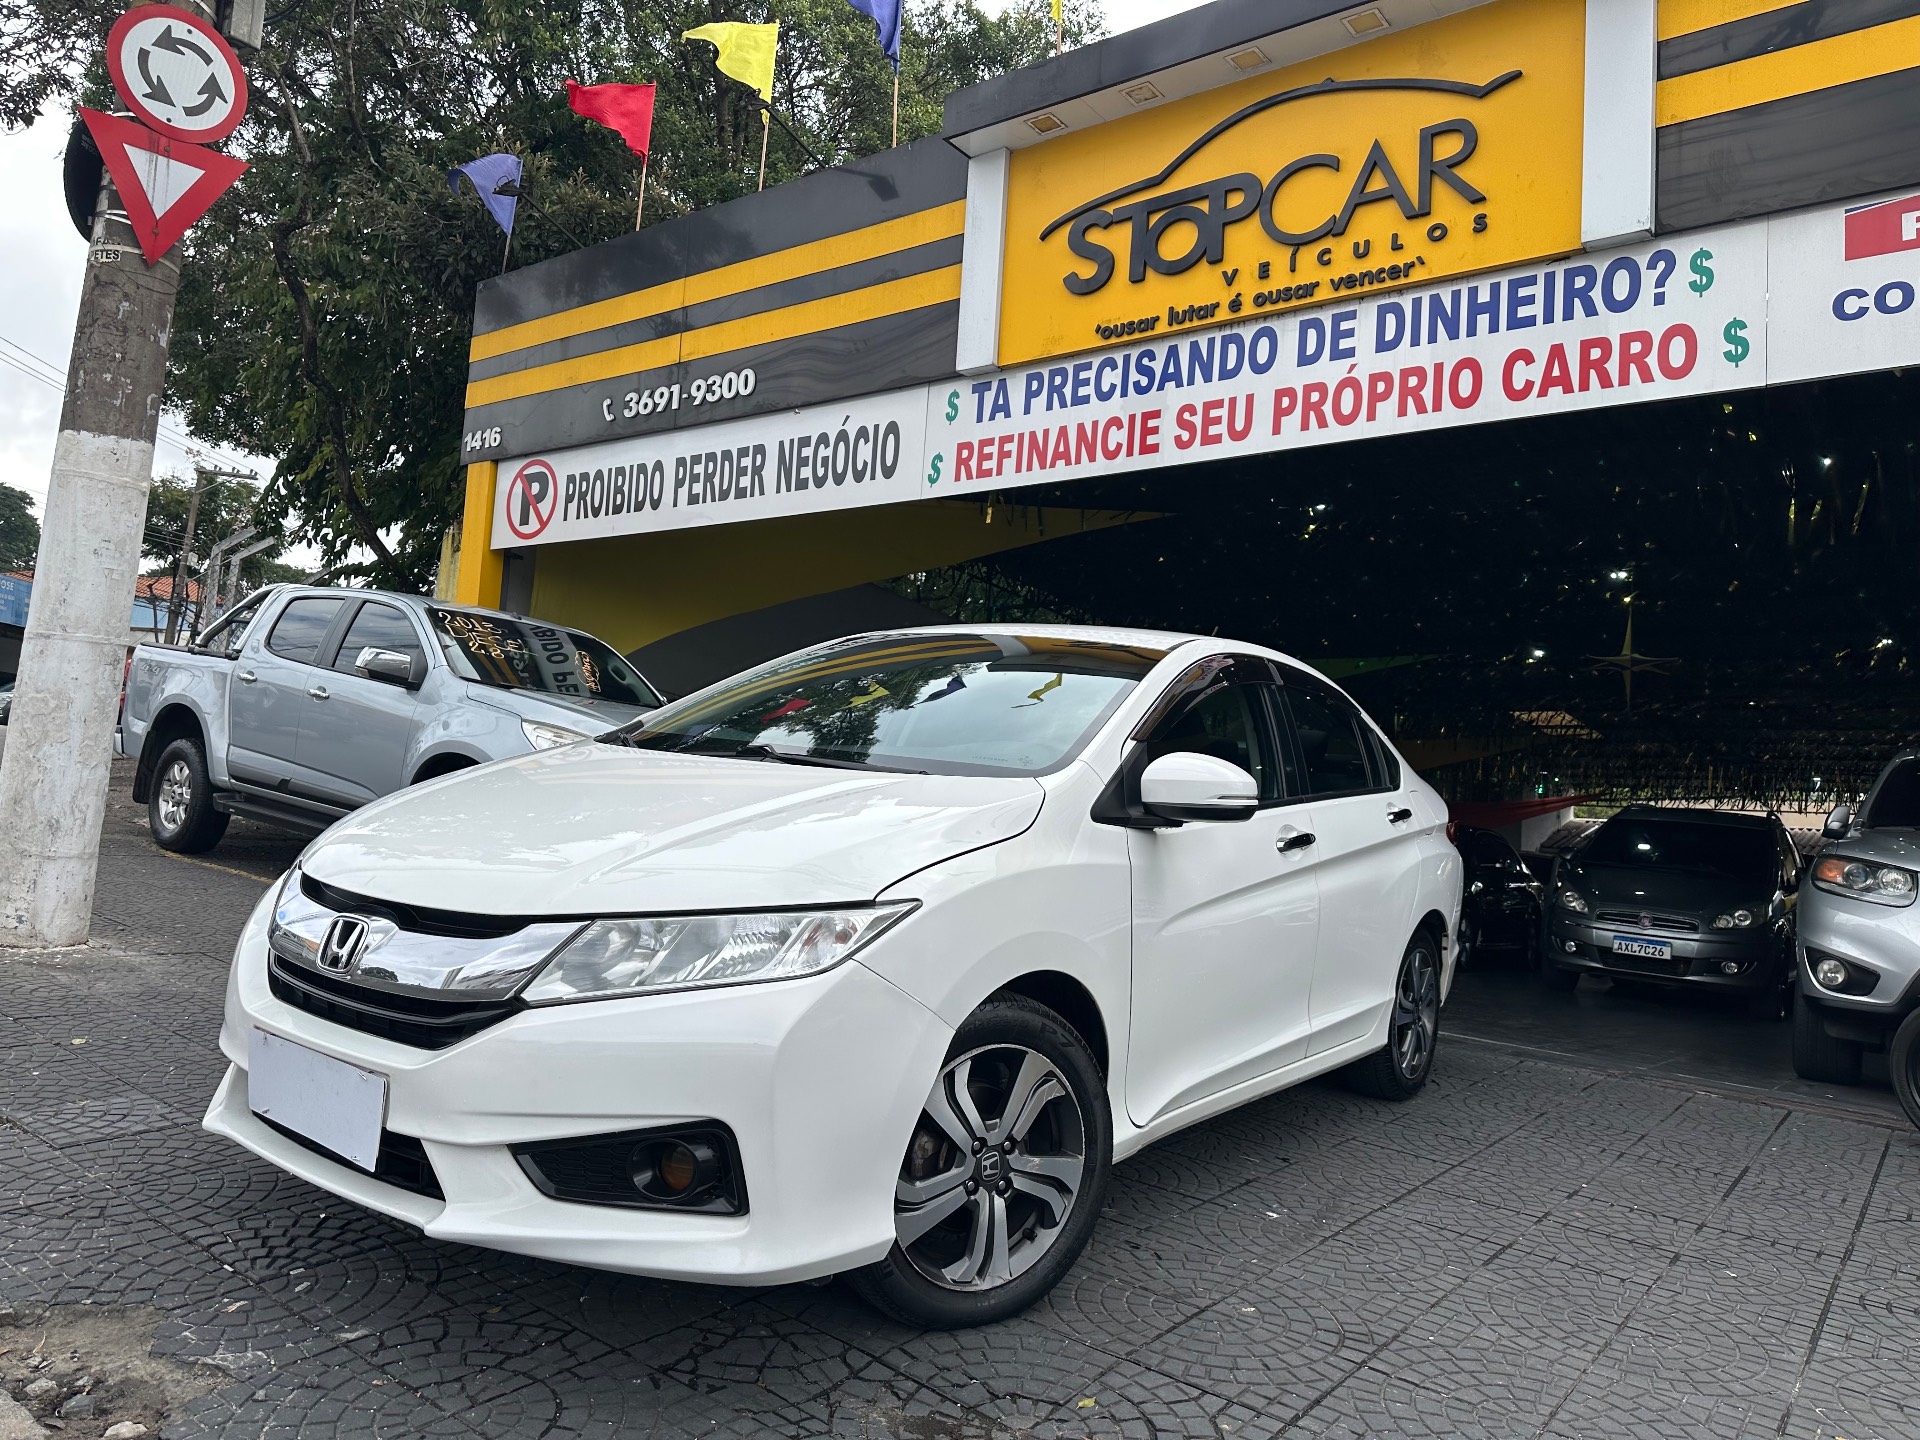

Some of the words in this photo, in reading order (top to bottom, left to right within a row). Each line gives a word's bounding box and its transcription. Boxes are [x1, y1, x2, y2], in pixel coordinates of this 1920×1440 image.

[1222, 213, 1487, 286] VEÍCULOS
[1167, 301, 1220, 327] lutar
[1227, 293, 1243, 313] é
[1252, 281, 1320, 307] ousar
[971, 377, 1012, 424] TA
[1023, 325, 1279, 416] PRECISANDO
[1296, 309, 1358, 368] DE
[1375, 248, 1676, 354] DINHEIRO?
[622, 368, 758, 419] 3691-9300
[953, 409, 1162, 483] REFINANCIE
[1173, 392, 1255, 450] SEU
[1271, 356, 1483, 436] PRÓPRIO
[1502, 323, 1698, 401] CARRO
[464, 426, 503, 452] 1416
[563, 459, 665, 522] PROIBIDO
[673, 443, 767, 508] PERDER
[776, 415, 901, 495] NEGÓCIO
[1617, 941, 1665, 957] AXL7C26
